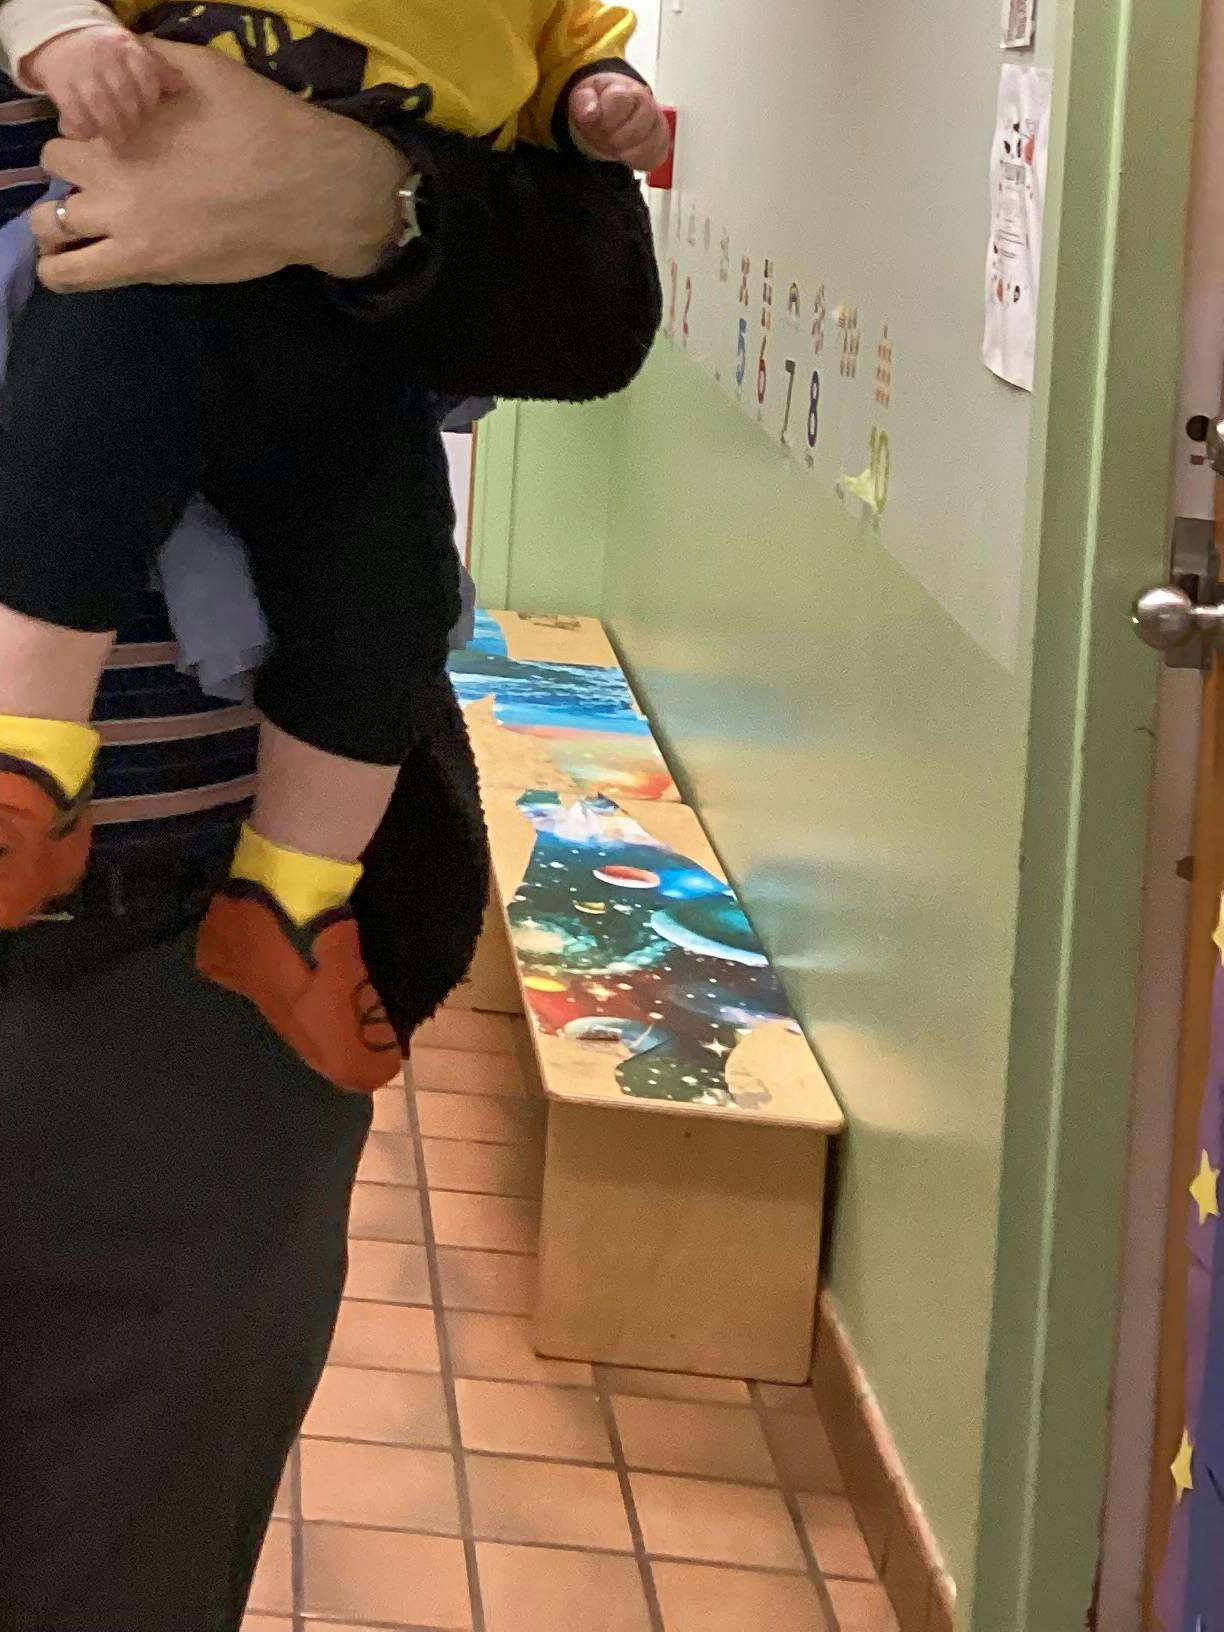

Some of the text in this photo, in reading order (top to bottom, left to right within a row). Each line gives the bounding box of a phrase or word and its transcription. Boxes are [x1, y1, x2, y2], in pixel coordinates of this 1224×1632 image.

[757, 335, 767, 405] 6
[783, 358, 796, 432] 7
[807, 370, 820, 448] 8
